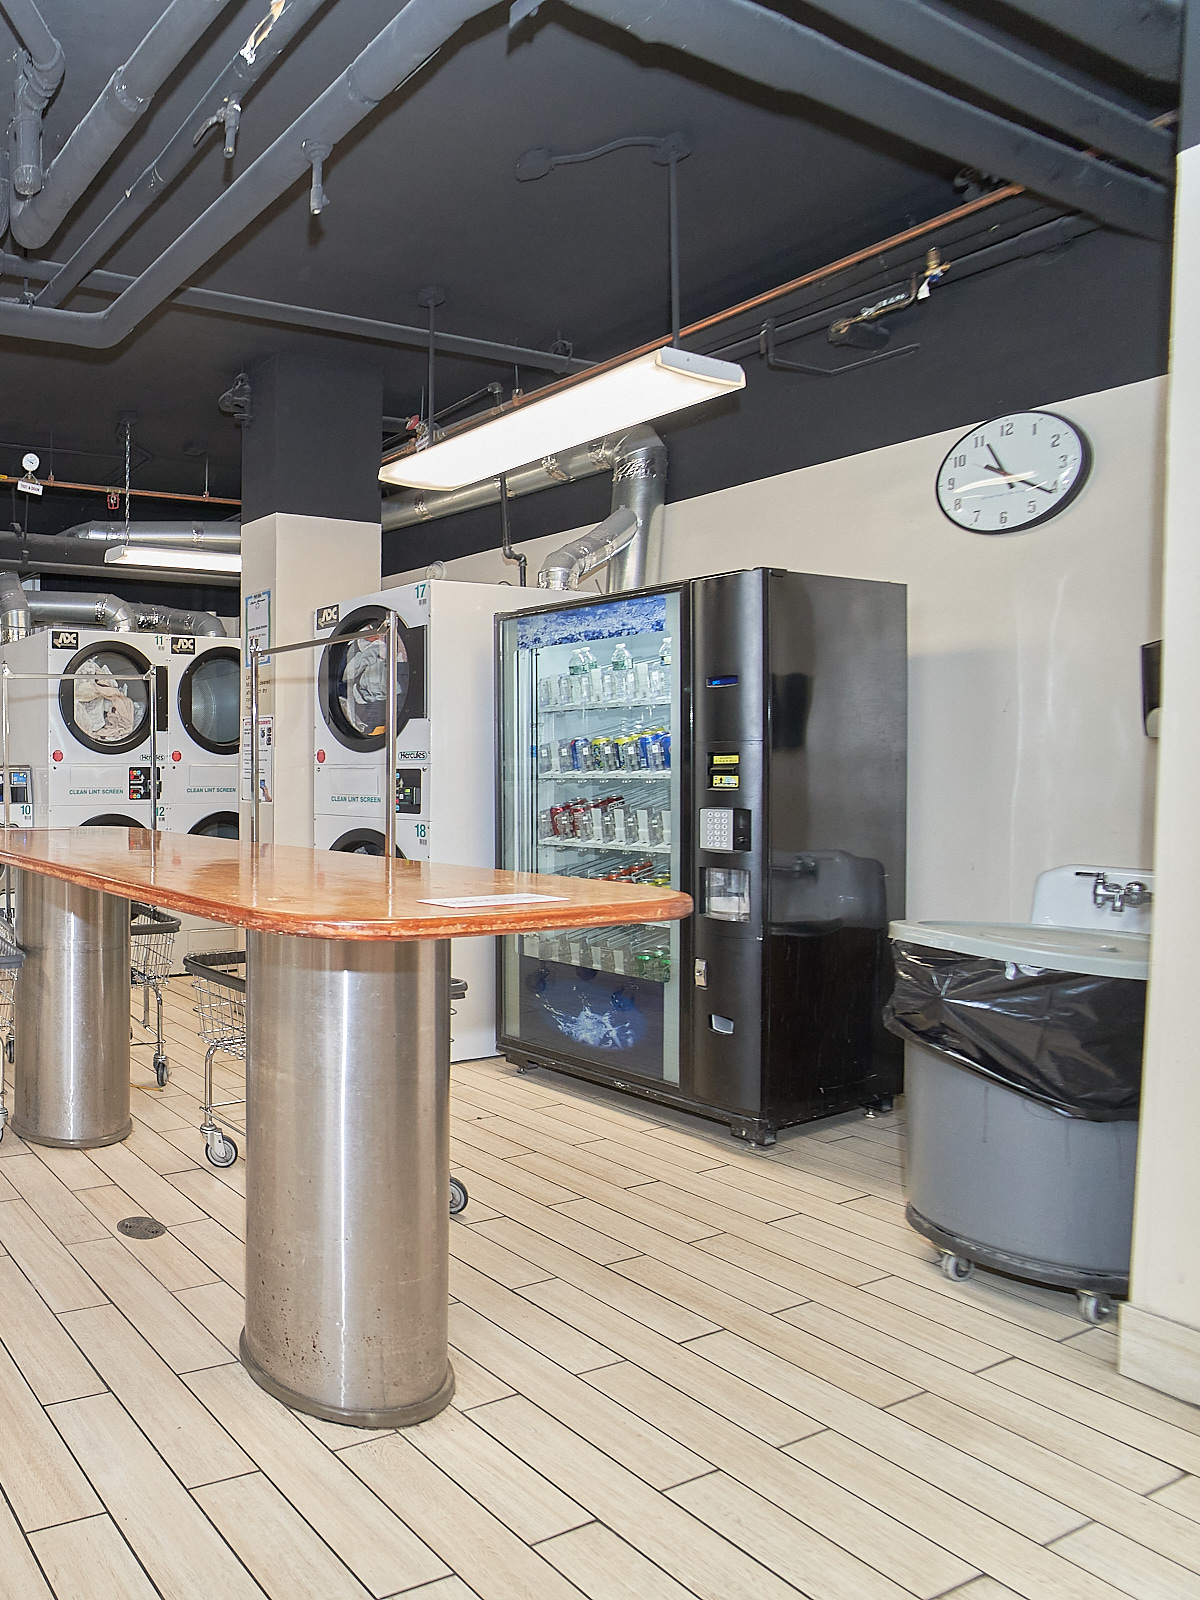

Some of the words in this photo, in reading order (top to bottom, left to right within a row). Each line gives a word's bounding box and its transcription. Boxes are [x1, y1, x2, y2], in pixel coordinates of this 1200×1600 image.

[1000, 422, 1014, 437] 12
[1032, 423, 1037, 435] 1
[974, 436, 985, 448] 11
[1051, 434, 1061, 448] 2
[953, 454, 966, 468] 10
[1058, 455, 1068, 469] 3
[948, 478, 955, 491] 9
[1050, 480, 1059, 493] 4
[954, 498, 961, 511] 8
[1027, 500, 1036, 514] 5
[973, 510, 981, 523] 7
[1000, 511, 1008, 524] 6
[414, 584, 426, 599] 17
[60, 632, 77, 644] ADC
[155, 636, 163, 645] 11
[177, 638, 194, 649] ADC
[400, 751, 426, 759] Hercules
[20, 805, 31, 815] 10
[415, 824, 426, 838] 18
